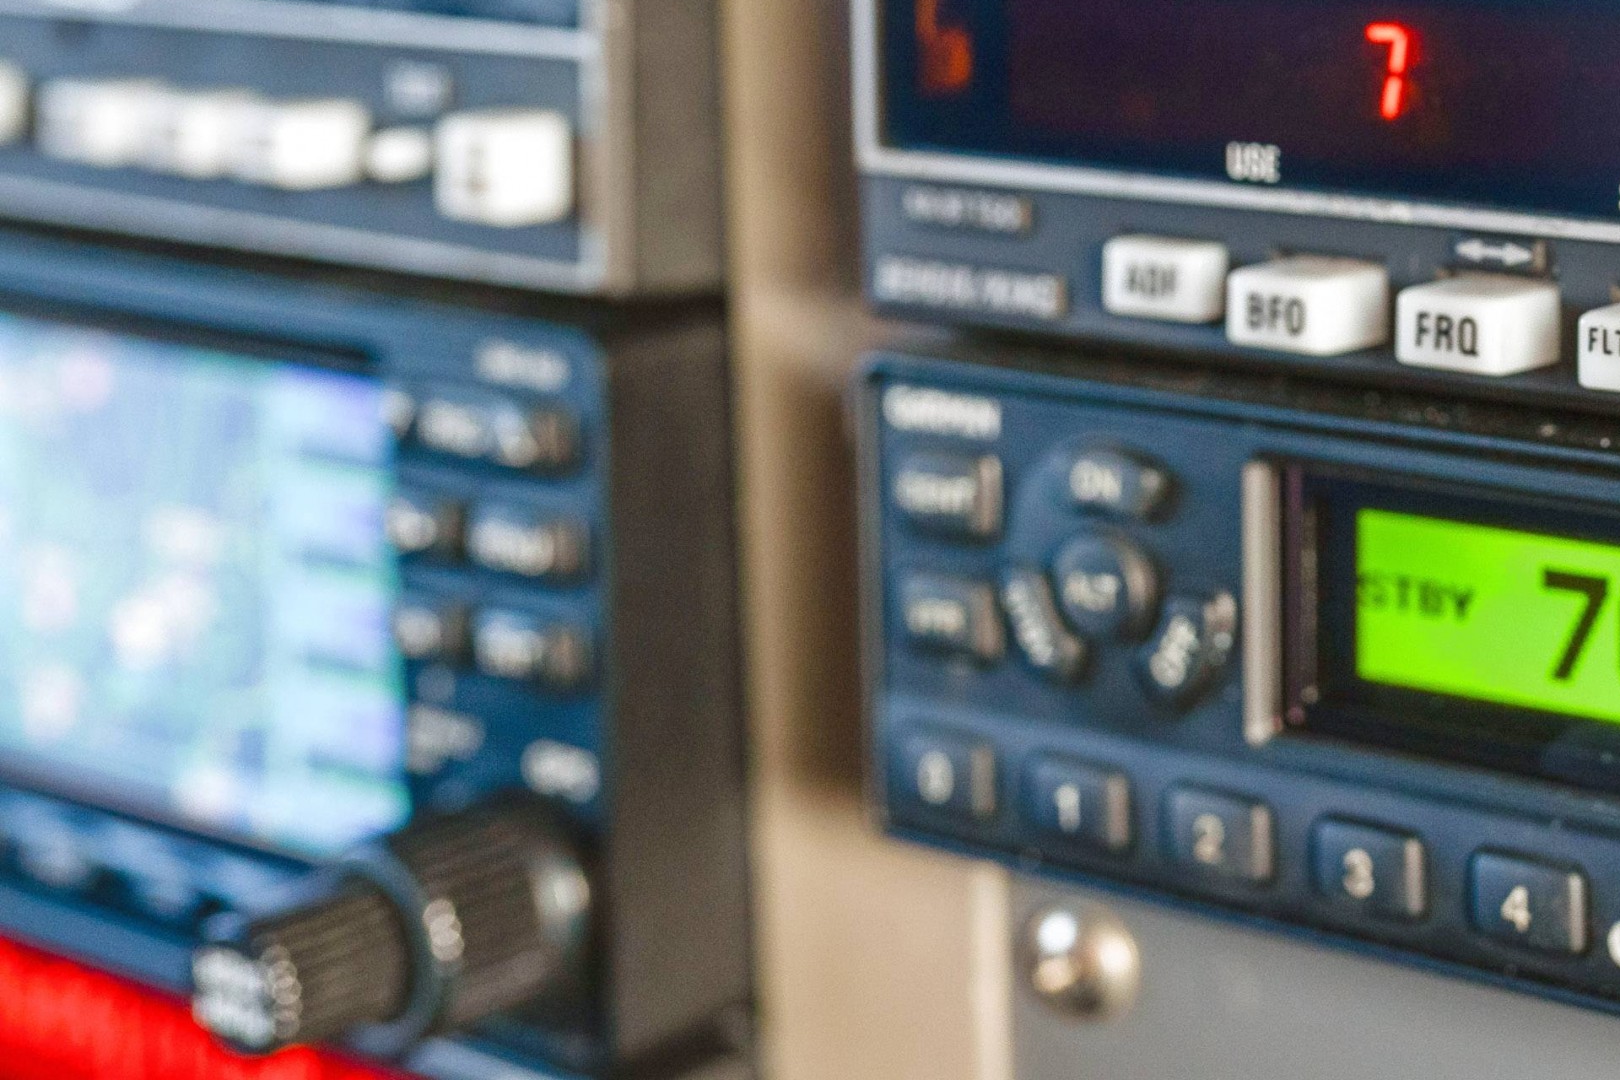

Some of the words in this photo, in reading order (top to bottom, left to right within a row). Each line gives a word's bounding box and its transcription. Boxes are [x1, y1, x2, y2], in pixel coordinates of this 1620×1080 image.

[1365, 21, 1409, 120] 7
[1246, 290, 1308, 338] BFO
[1415, 311, 1479, 358] FRQ
[1341, 848, 1375, 900] 3
[1501, 885, 1531, 933] 4
